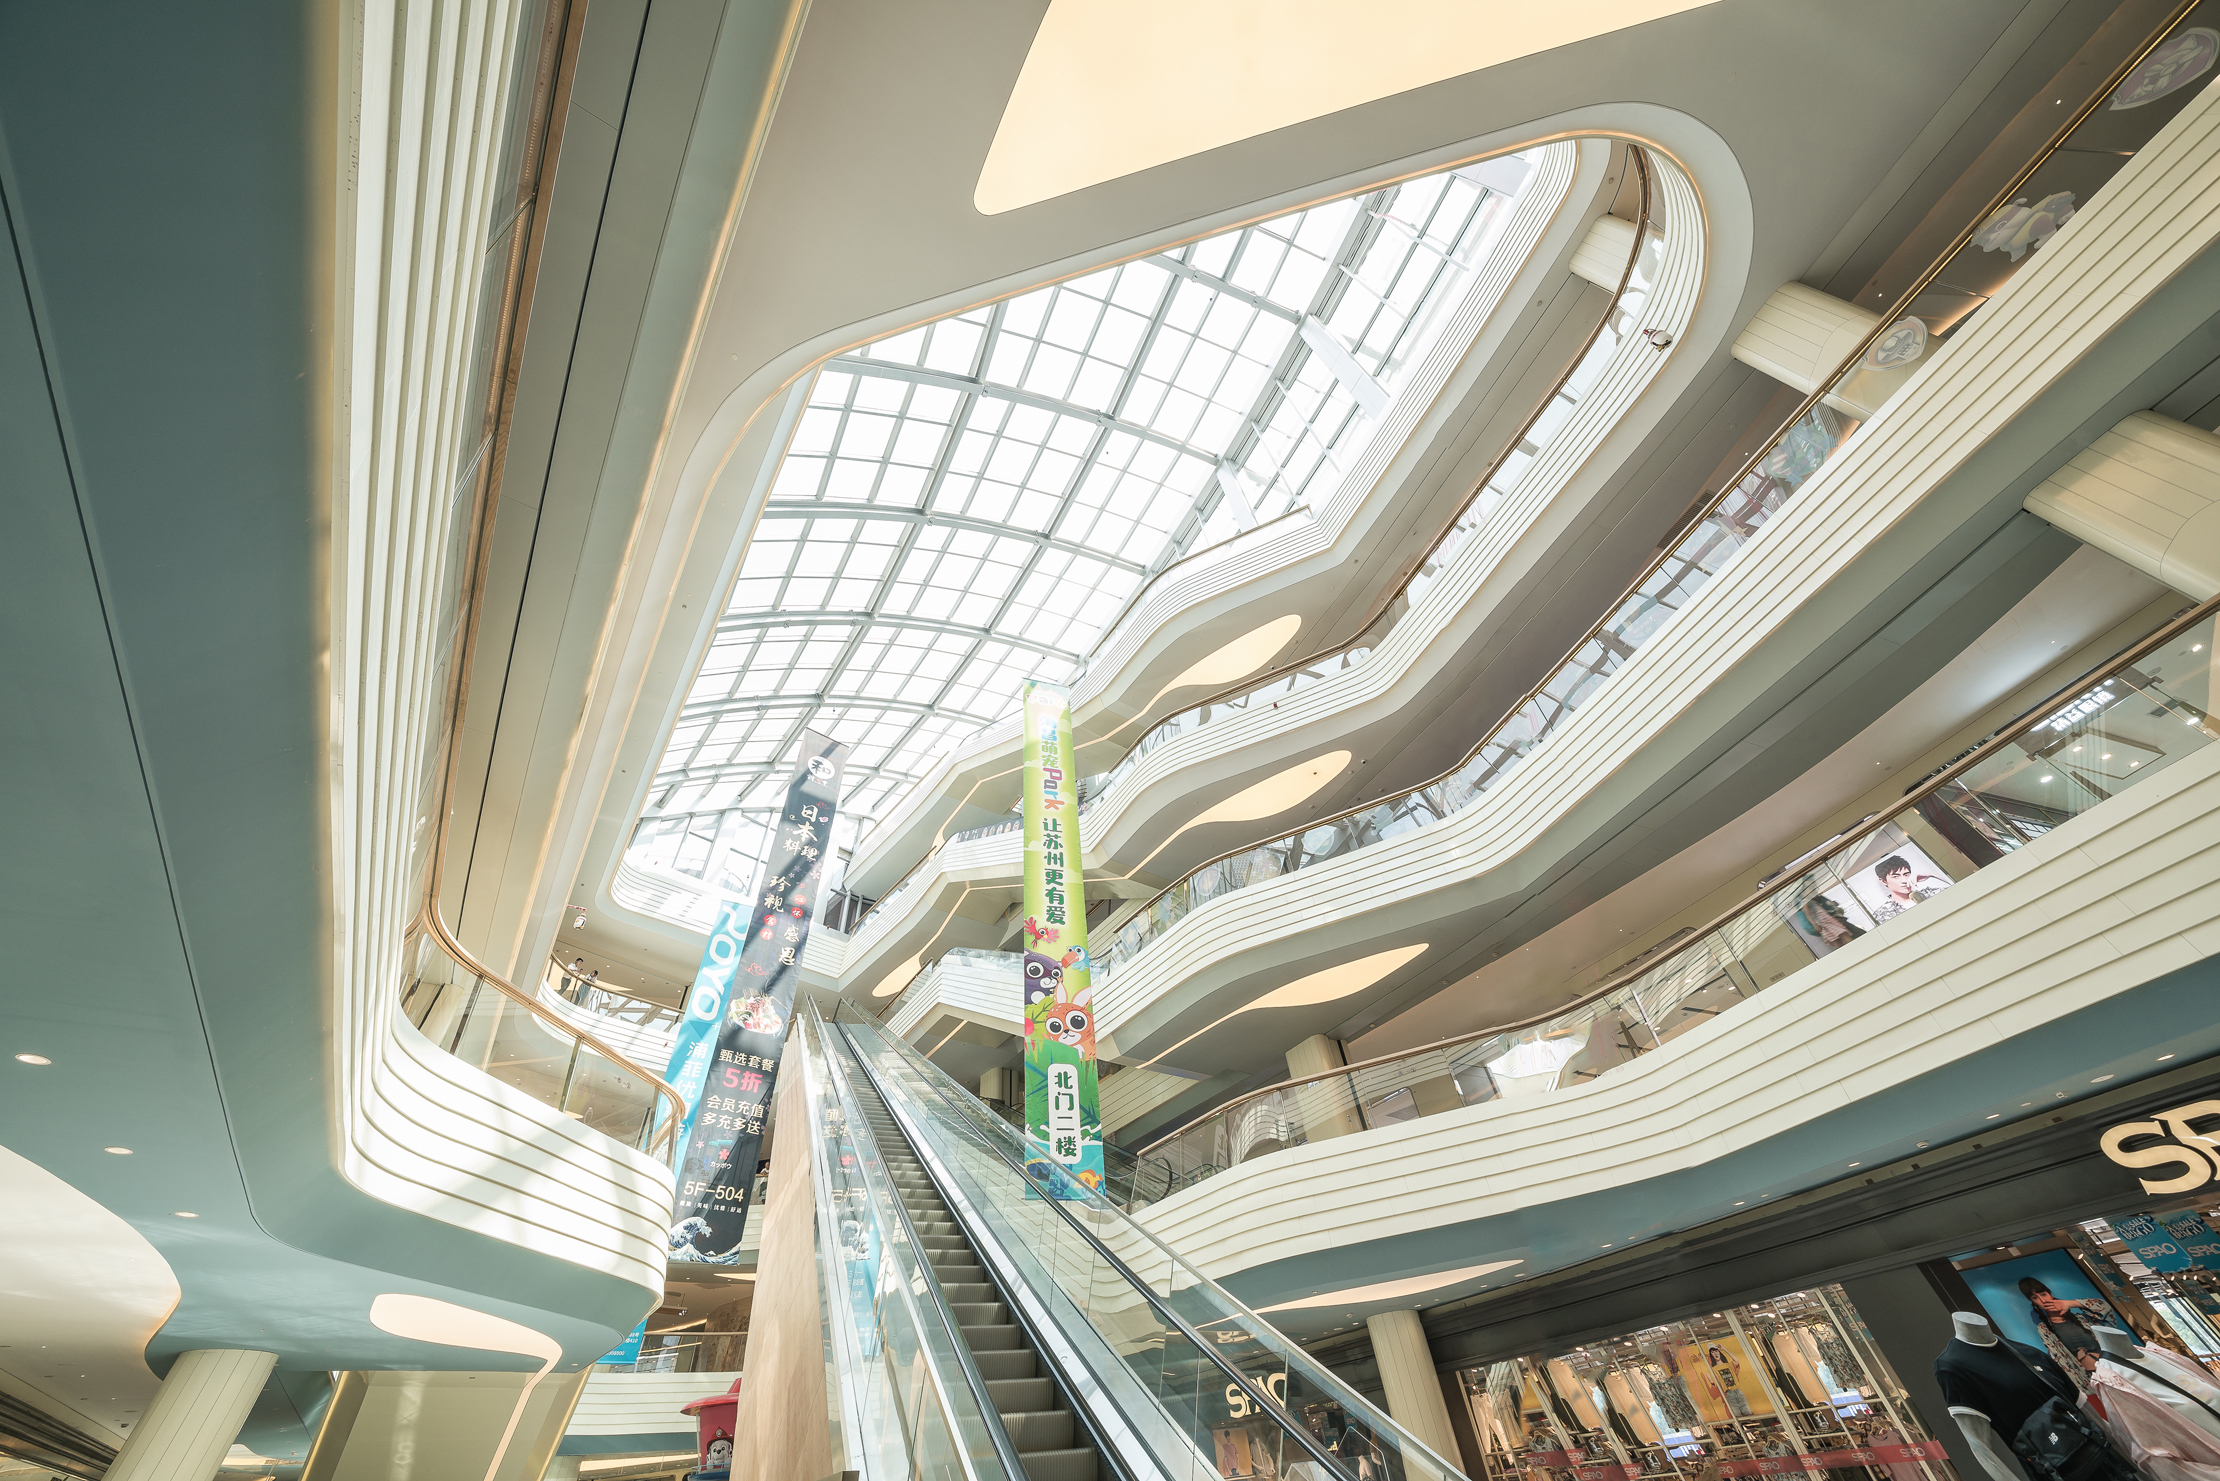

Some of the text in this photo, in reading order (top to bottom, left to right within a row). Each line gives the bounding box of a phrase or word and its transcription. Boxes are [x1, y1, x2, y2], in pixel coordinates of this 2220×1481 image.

[1042, 817, 1066, 926] 让苏州更有爱
[718, 1048, 775, 1073] 甄选套餐
[722, 1068, 763, 1094] 5折
[706, 1094, 766, 1119] 会员充值
[1054, 1071, 1077, 1157] 北门二楼
[701, 1111, 762, 1136] 多充多送
[2138, 1242, 2177, 1259] SPAO
[1800, 1457, 1823, 1467] SPAO
[1851, 1451, 1875, 1462] SPAO
[1899, 1447, 1926, 1458] SPAO
[1582, 1471, 1603, 1480] SPAO
[1759, 1461, 1780, 1471] SPAO
